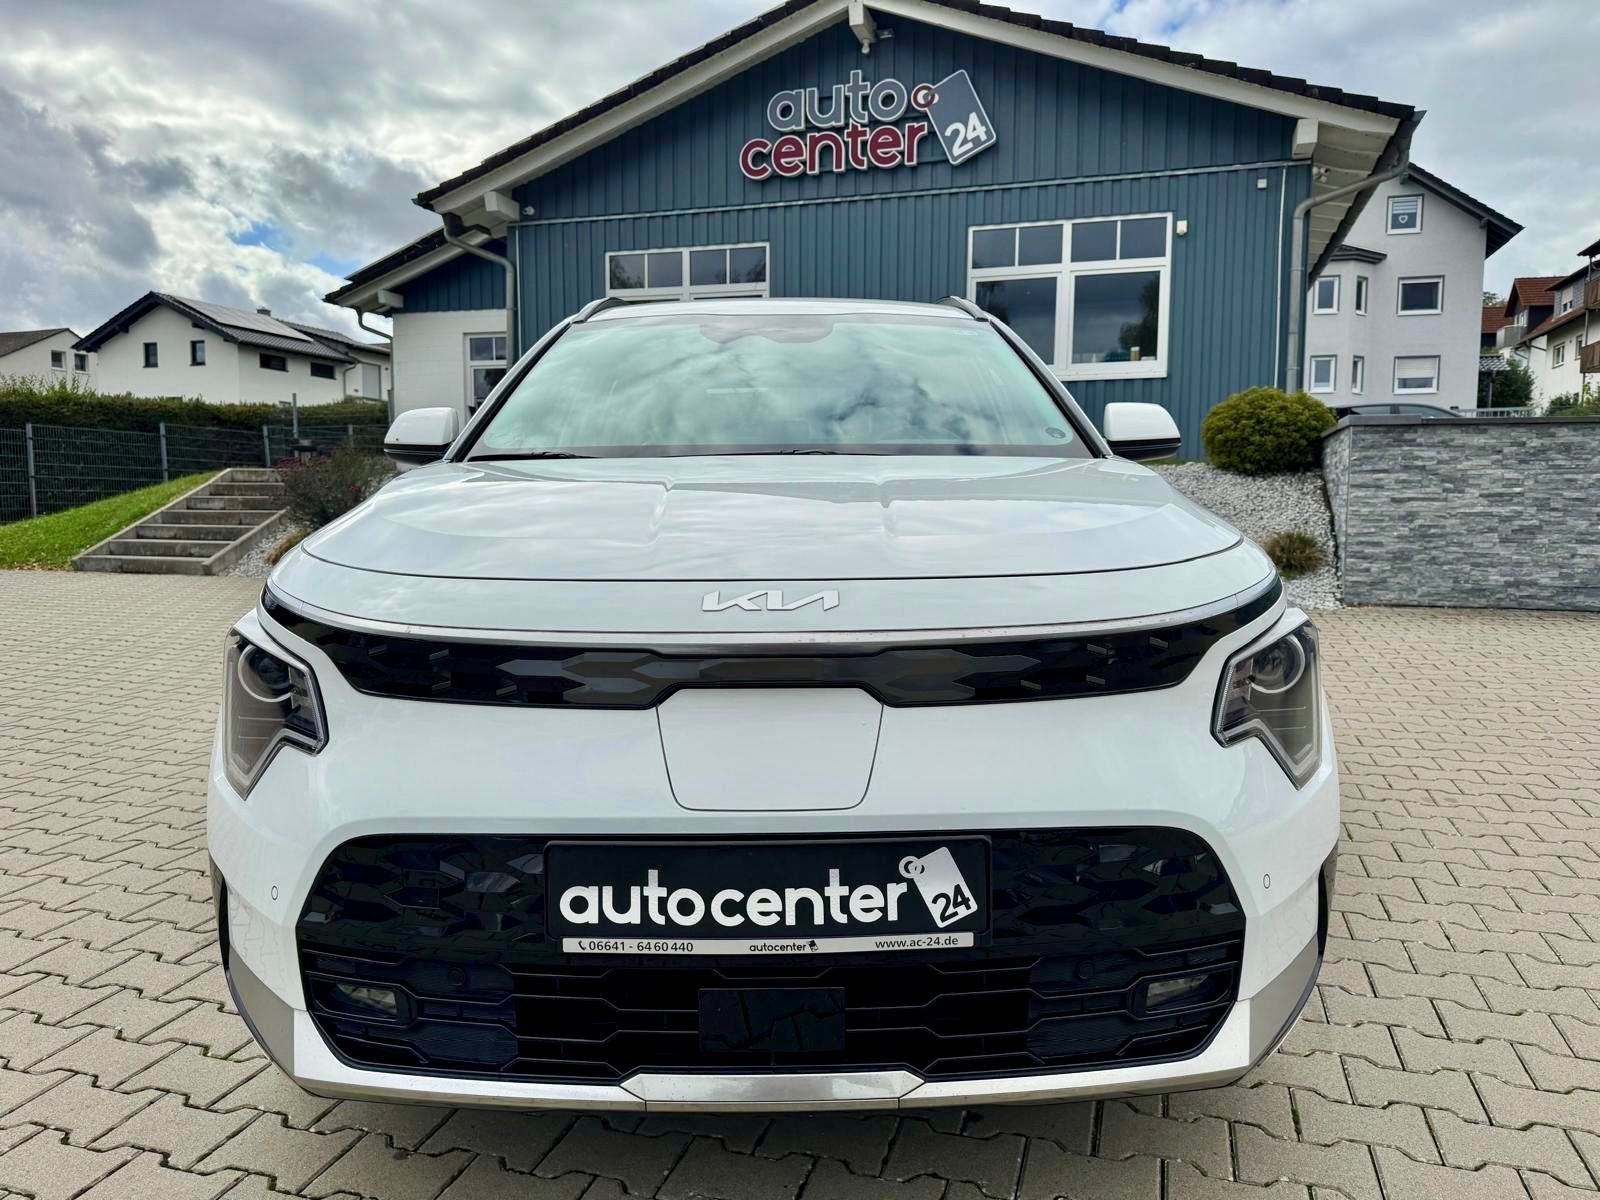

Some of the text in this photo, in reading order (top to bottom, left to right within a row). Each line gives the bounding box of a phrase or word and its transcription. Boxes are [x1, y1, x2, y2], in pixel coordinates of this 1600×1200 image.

[767, 69, 908, 132] auto
[739, 119, 929, 180] center
[944, 111, 988, 157] 24
[931, 883, 972, 923] 24
[588, 940, 625, 952] 06641
[749, 942, 807, 952] autocenter
[875, 936, 959, 949] www.ac-24.de
